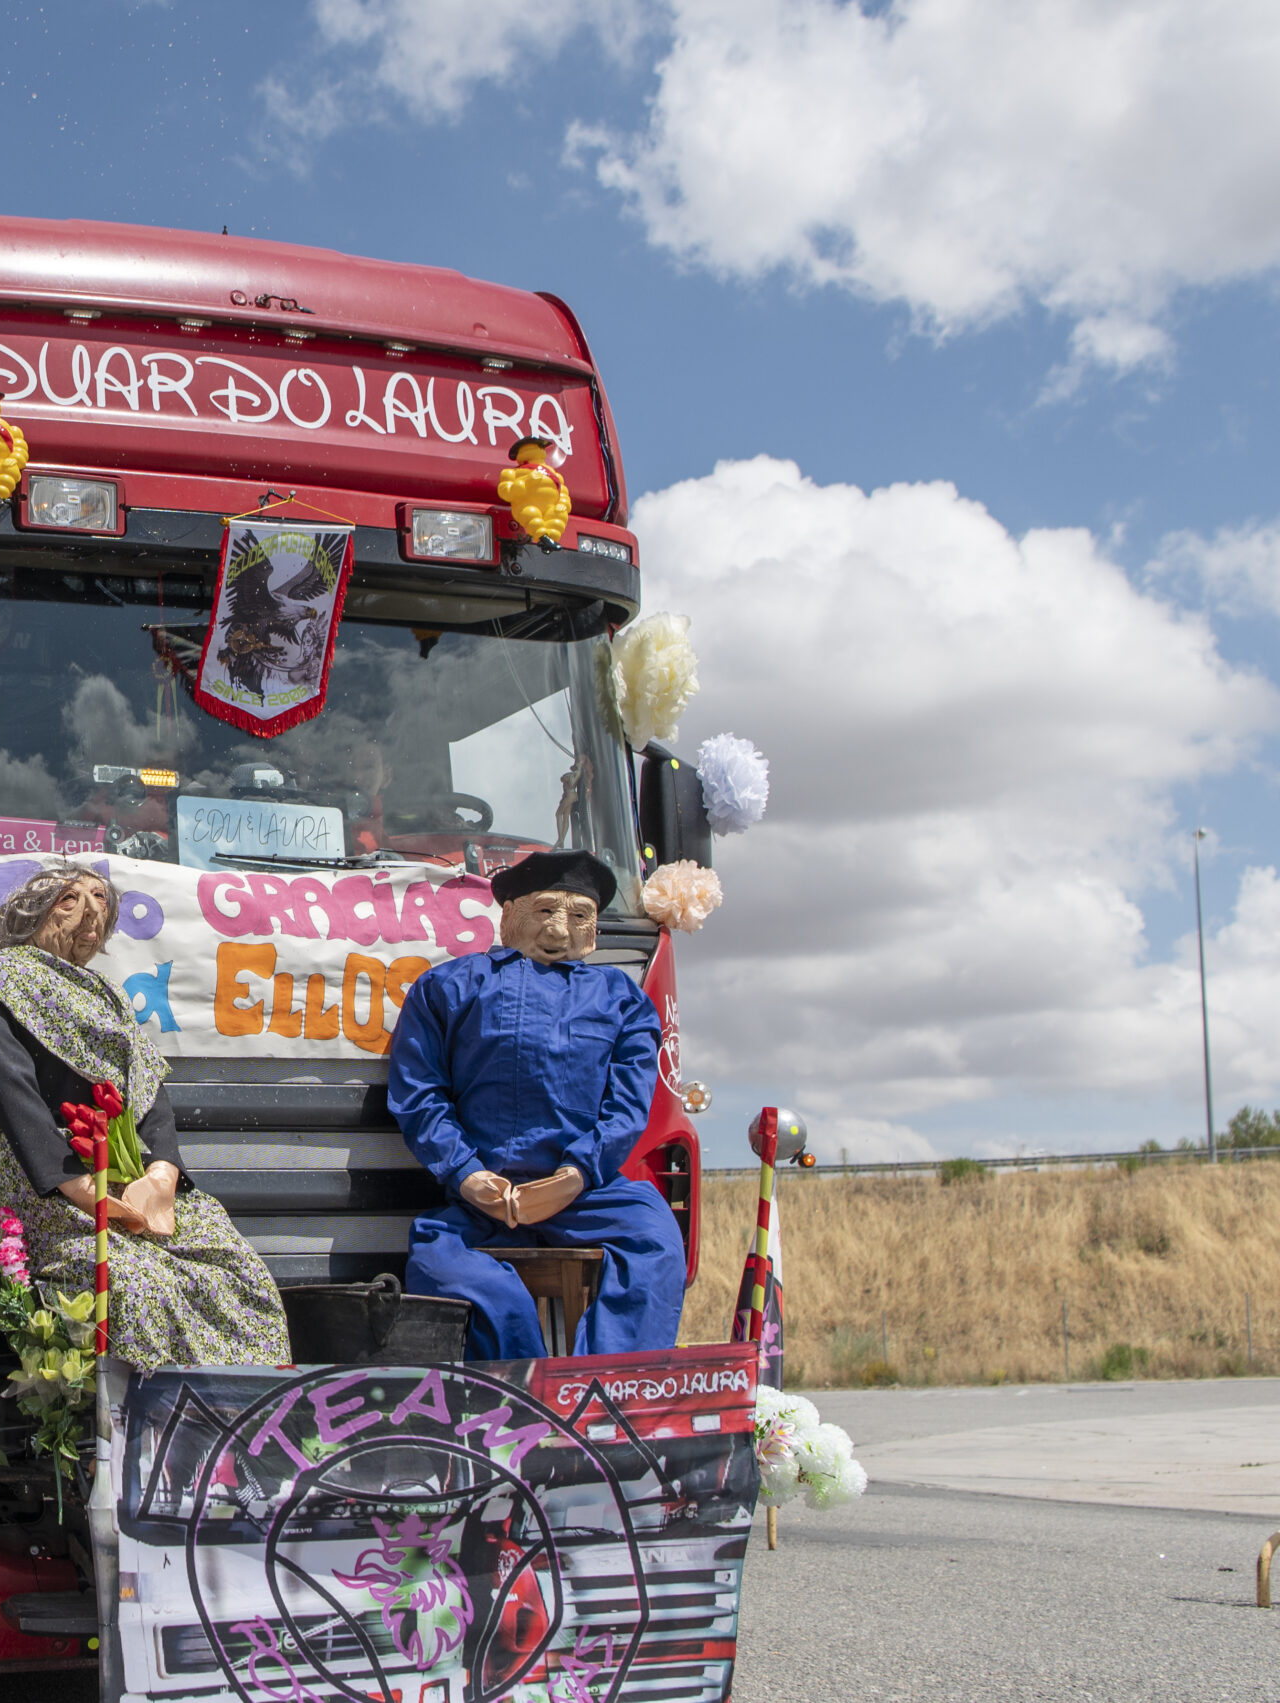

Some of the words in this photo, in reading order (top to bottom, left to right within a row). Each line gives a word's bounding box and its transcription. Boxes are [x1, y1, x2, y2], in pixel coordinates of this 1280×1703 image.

[345, 365, 574, 456] LAURA
[212, 678, 264, 707] SINCE
[23, 830, 43, 852] &
[50, 831, 105, 853] Lena
[192, 808, 242, 844] EDU
[258, 812, 331, 851] LAURA
[679, 1369, 750, 1395] LAURA
[247, 1368, 552, 1471] TEAM
